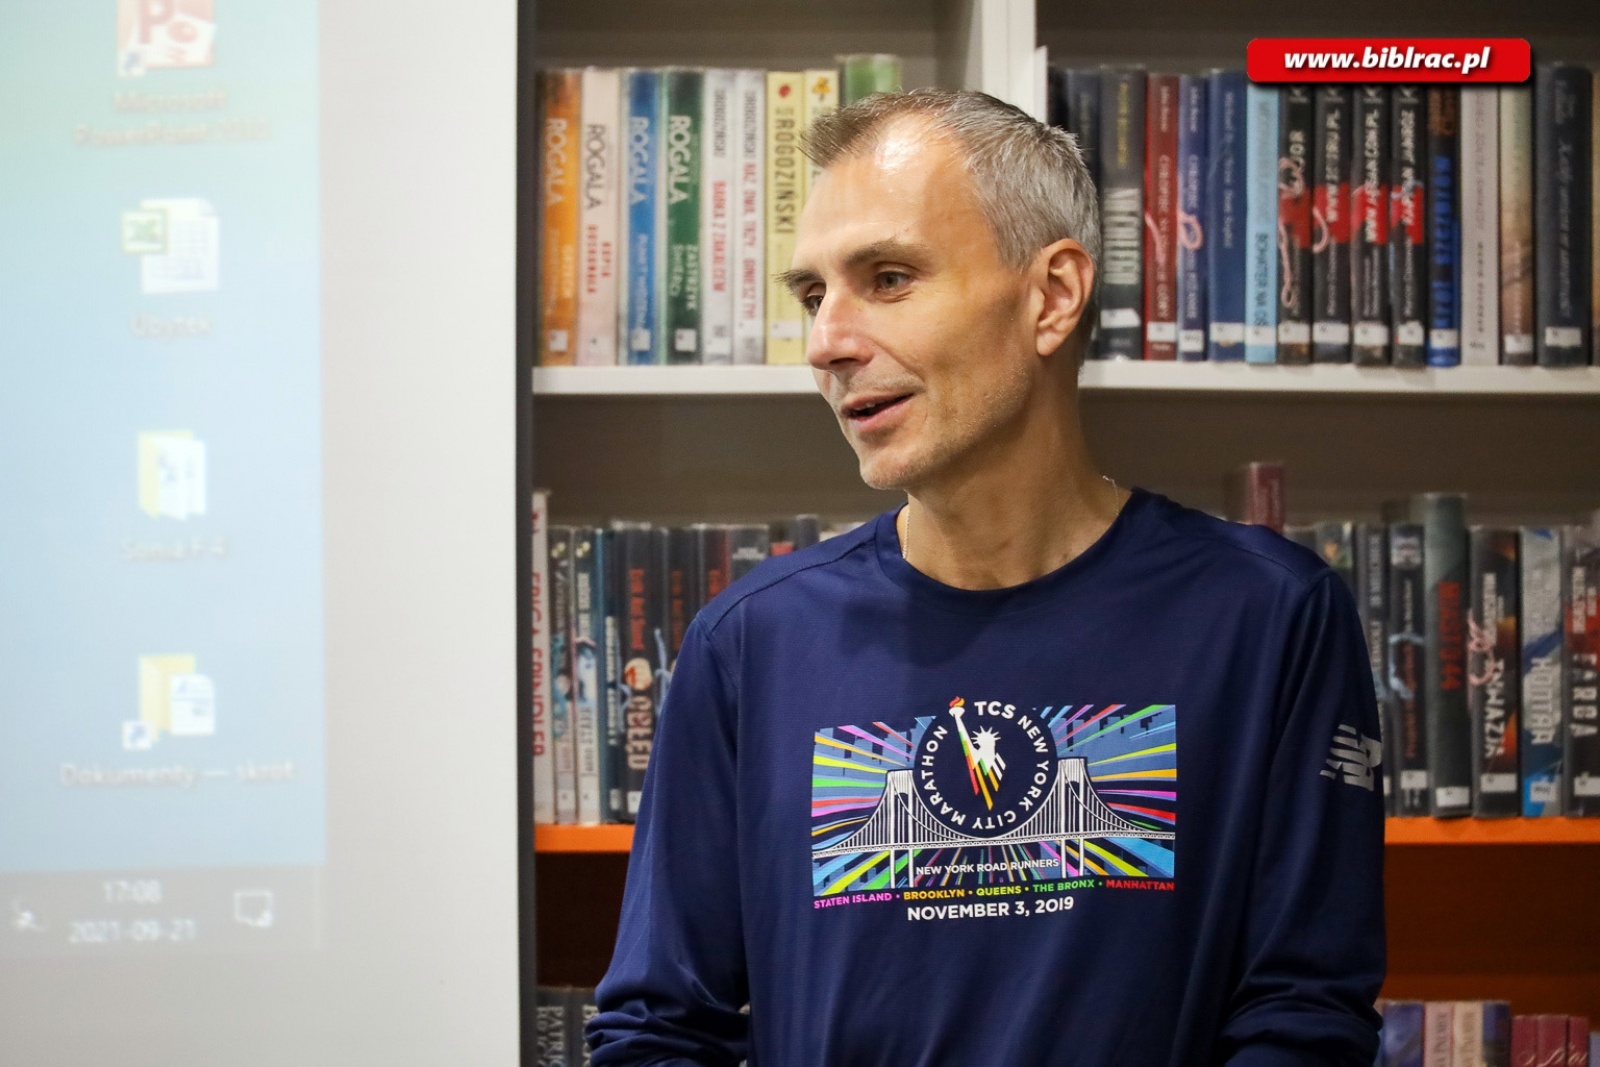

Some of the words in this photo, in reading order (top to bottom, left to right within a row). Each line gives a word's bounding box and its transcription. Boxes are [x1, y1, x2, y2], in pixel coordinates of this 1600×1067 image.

[546, 117, 568, 206] ROGALA
[586, 123, 606, 210] ROGALA
[630, 116, 650, 205] ROGALA
[669, 115, 691, 205] ROGALA
[775, 118, 797, 235] ROGOZIŃSKI
[974, 701, 1016, 720] TCS
[1482, 657, 1506, 758] INWAZJA
[1017, 715, 1049, 754] NEW
[921, 725, 968, 826] MARATHON
[1018, 760, 1050, 812] YORK
[971, 810, 1017, 830] CITY
[102, 879, 163, 905] 17:08
[916, 866, 942, 876] NEW
[944, 864, 975, 875] YORK
[976, 862, 1010, 873] ROAD
[1010, 858, 1060, 871] RUNNERS
[813, 896, 850, 909] STATEN
[852, 892, 893, 904] ISLAND
[903, 889, 965, 900] BROOKLYN
[976, 885, 1022, 897] QUEENS
[1032, 883, 1055, 893] THE
[1057, 879, 1095, 892] BRONX
[1106, 879, 1175, 891] MANHATTAN
[907, 902, 1010, 921] NOVEMBER
[1014, 901, 1030, 917] 3,
[1034, 896, 1075, 914] 2019
